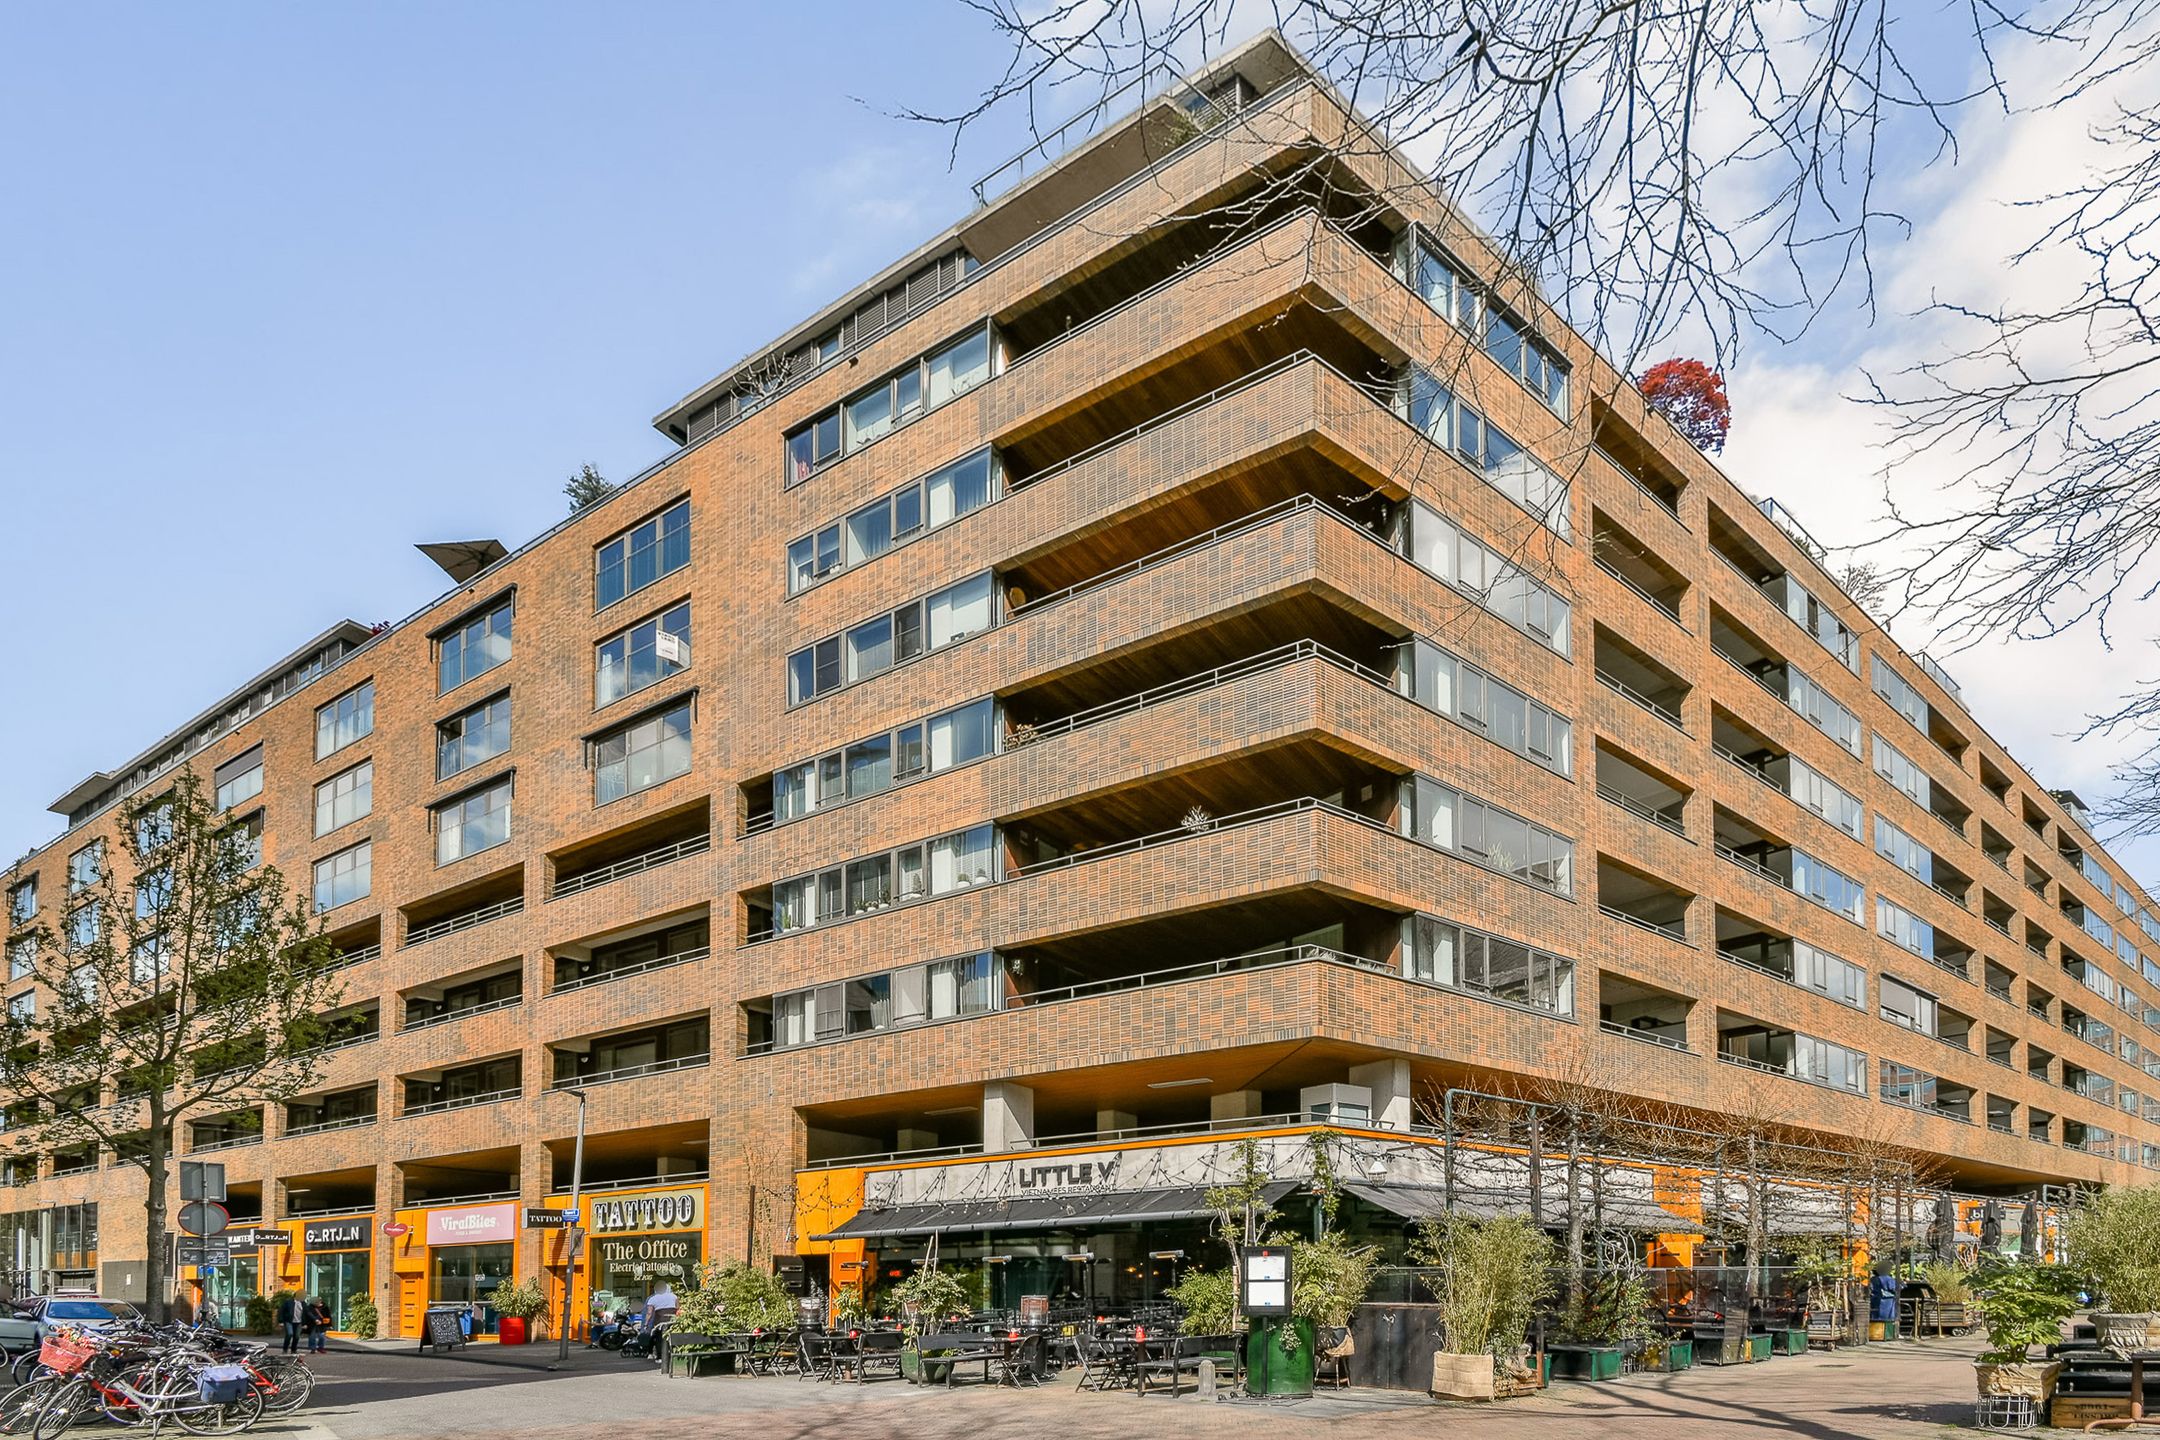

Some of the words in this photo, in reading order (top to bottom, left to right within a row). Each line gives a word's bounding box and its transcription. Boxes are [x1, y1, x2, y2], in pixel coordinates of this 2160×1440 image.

[1019, 1163, 1093, 1188] LITTLE
[1020, 1186, 1067, 1197] VIETNAMEES
[1067, 1183, 1117, 1195] RESTAURANT
[529, 1215, 563, 1223] TATTOO
[593, 1194, 694, 1231] TATTOO
[440, 1214, 497, 1231] ViralBites
[603, 1242, 634, 1261] The
[638, 1239, 688, 1260] Office
